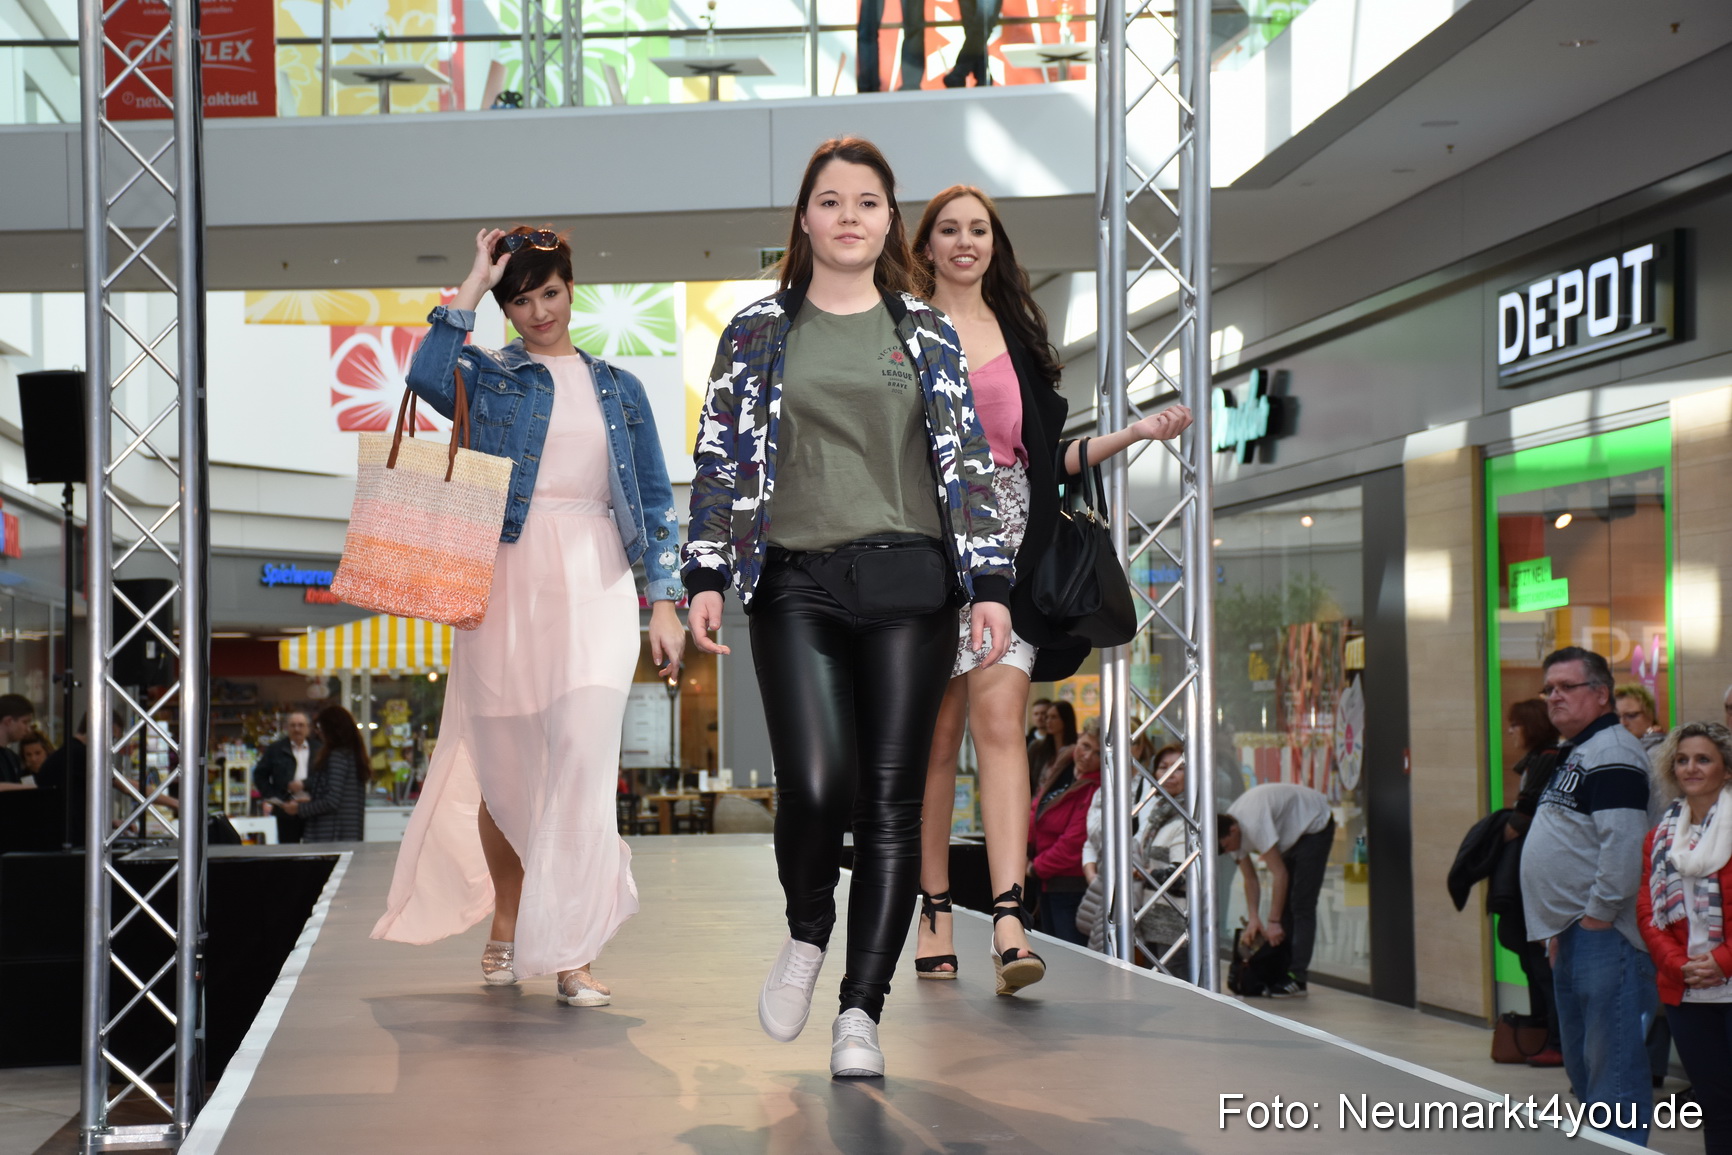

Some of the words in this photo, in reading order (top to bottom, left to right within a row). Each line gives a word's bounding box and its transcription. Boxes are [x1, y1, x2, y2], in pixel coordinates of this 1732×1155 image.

[124, 39, 252, 64] CINLEX
[1498, 243, 1653, 366] DEPOT
[882, 370, 912, 380] LEAGUE
[262, 563, 333, 587] Spielwaren
